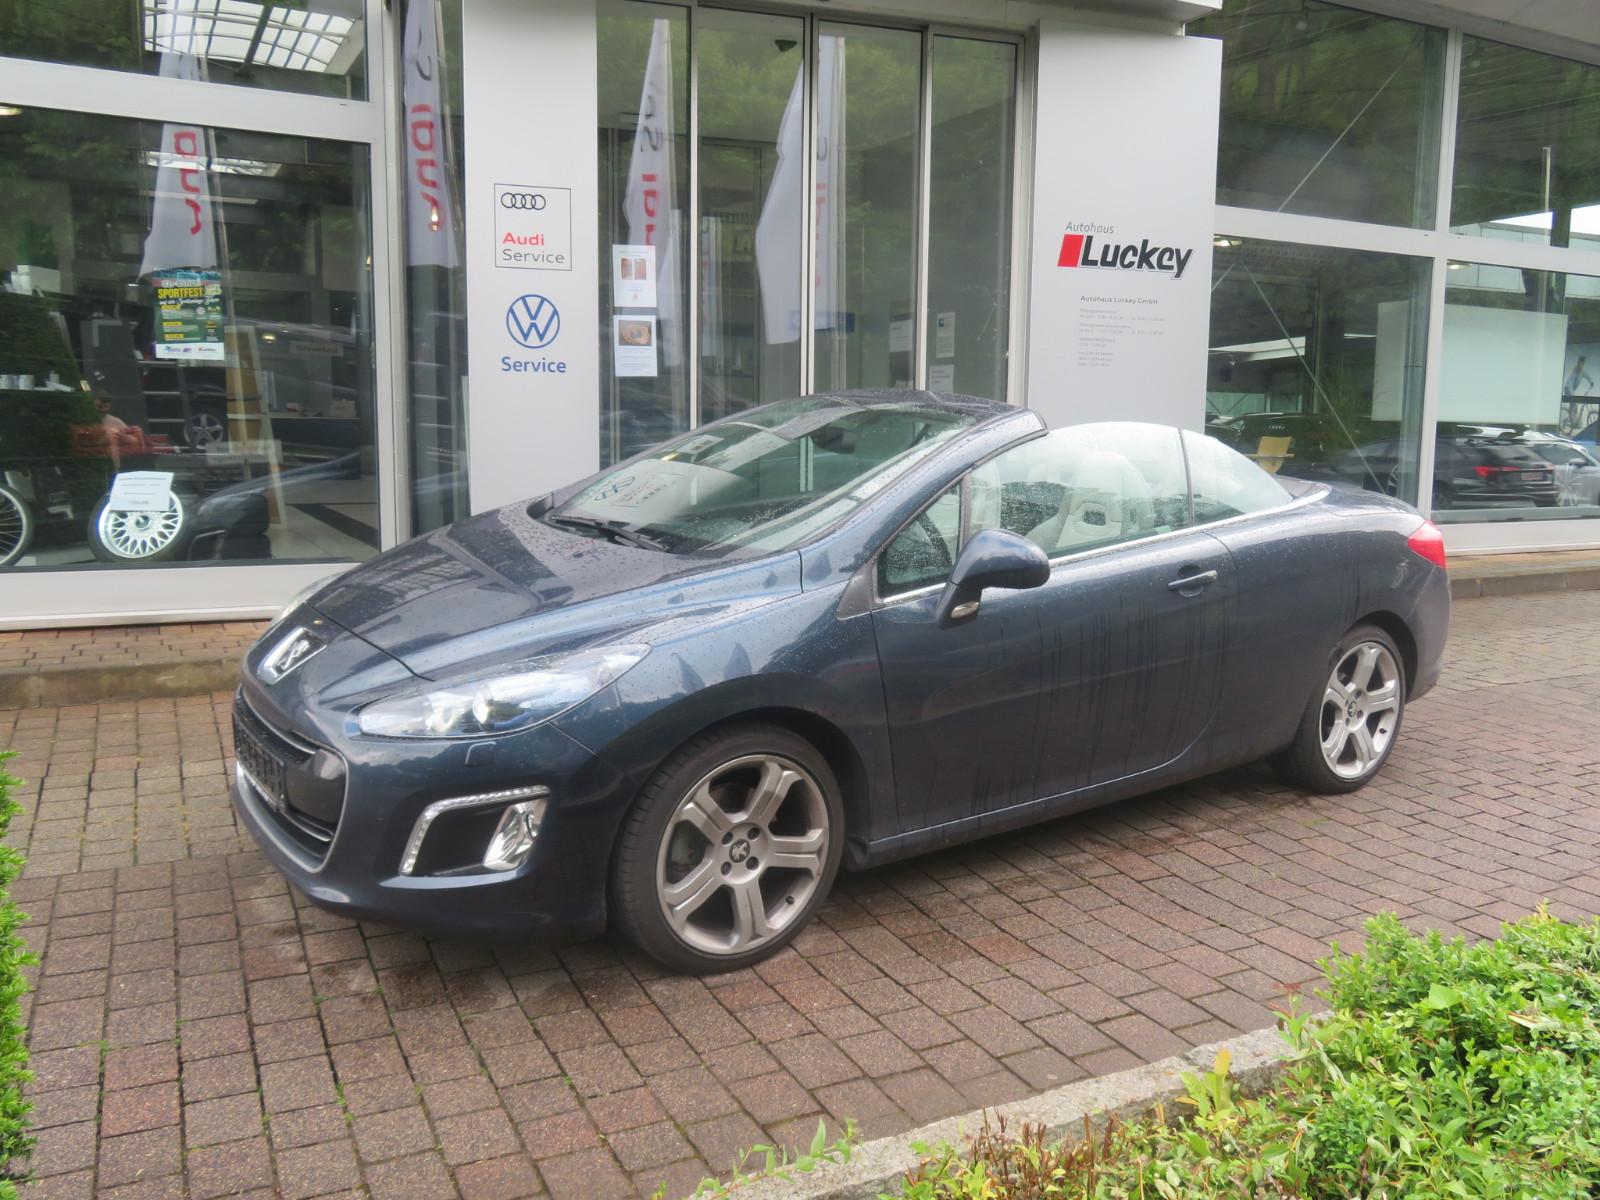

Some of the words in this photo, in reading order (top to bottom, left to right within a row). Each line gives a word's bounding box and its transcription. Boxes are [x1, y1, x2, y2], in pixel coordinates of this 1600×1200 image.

[1065, 221, 1115, 235] Autohaus
[502, 231, 545, 247] Audi
[501, 248, 566, 265] Service
[1080, 235, 1193, 280] Luckey
[158, 287, 204, 299] SPORTFEST
[501, 355, 567, 374] Service
